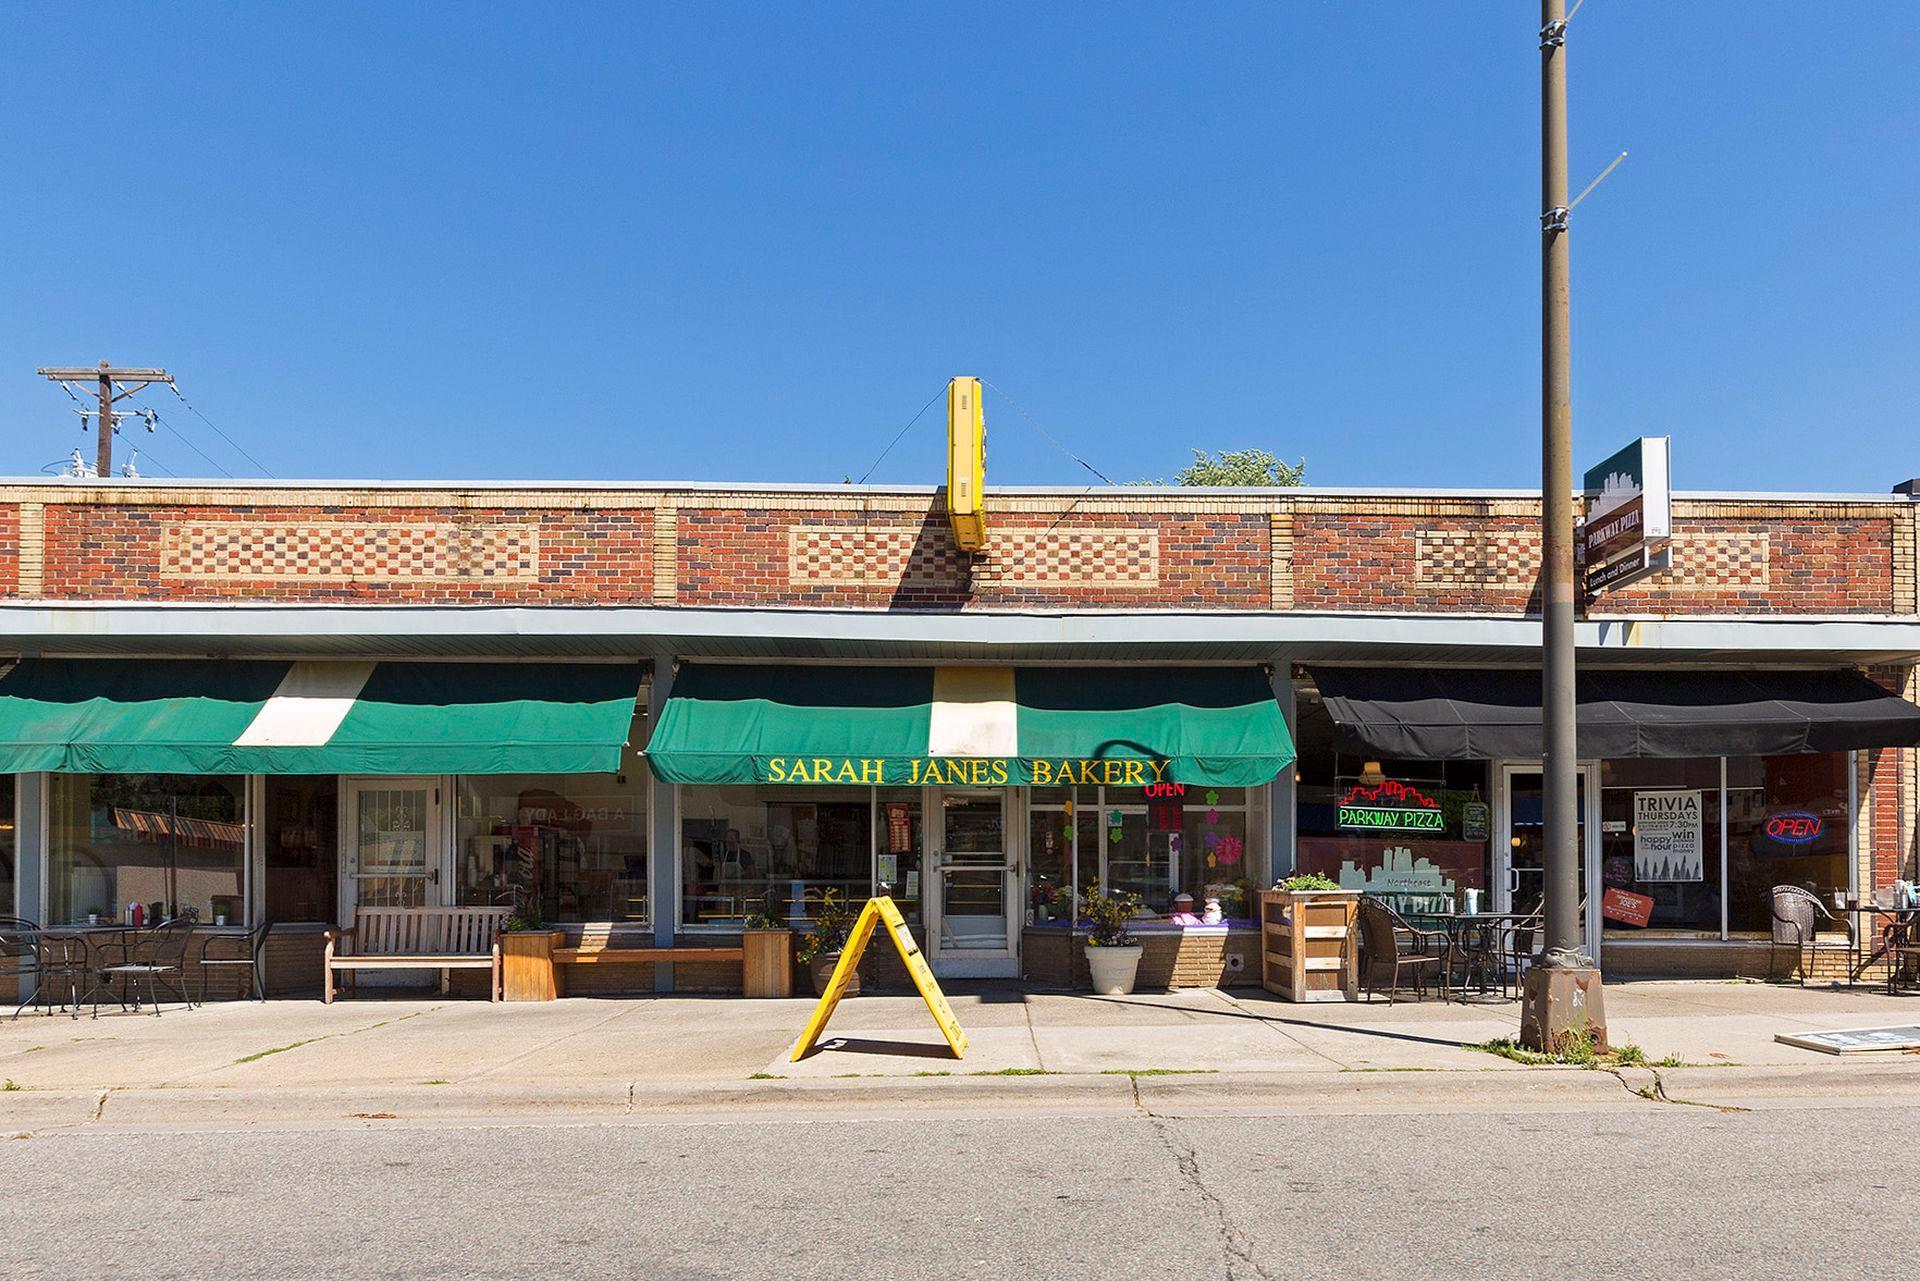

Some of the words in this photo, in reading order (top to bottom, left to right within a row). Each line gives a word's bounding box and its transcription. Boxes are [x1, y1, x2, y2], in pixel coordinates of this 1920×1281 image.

[1588, 519, 1620, 548] PARKWAY
[1620, 509, 1640, 531] PIZZA
[1589, 571, 1607, 587] Lunch
[1606, 566, 1619, 578] and
[1620, 557, 1641, 573] Dinner
[768, 757, 885, 784] SARAH
[906, 757, 1008, 785] JANES
[1031, 758, 1171, 785] BAKERY
[1144, 782, 1185, 798] OPEN
[1638, 797, 1698, 811] TRIVIA
[1339, 809, 1400, 826] PARKWAY
[1404, 812, 1445, 828] PIZZA
[1638, 811, 1698, 821] THURSDAYS
[1671, 828, 1695, 840] win
[1766, 818, 1822, 836] OPEN
[1640, 835, 1672, 845] happy
[1386, 878, 1432, 888] Northeast
